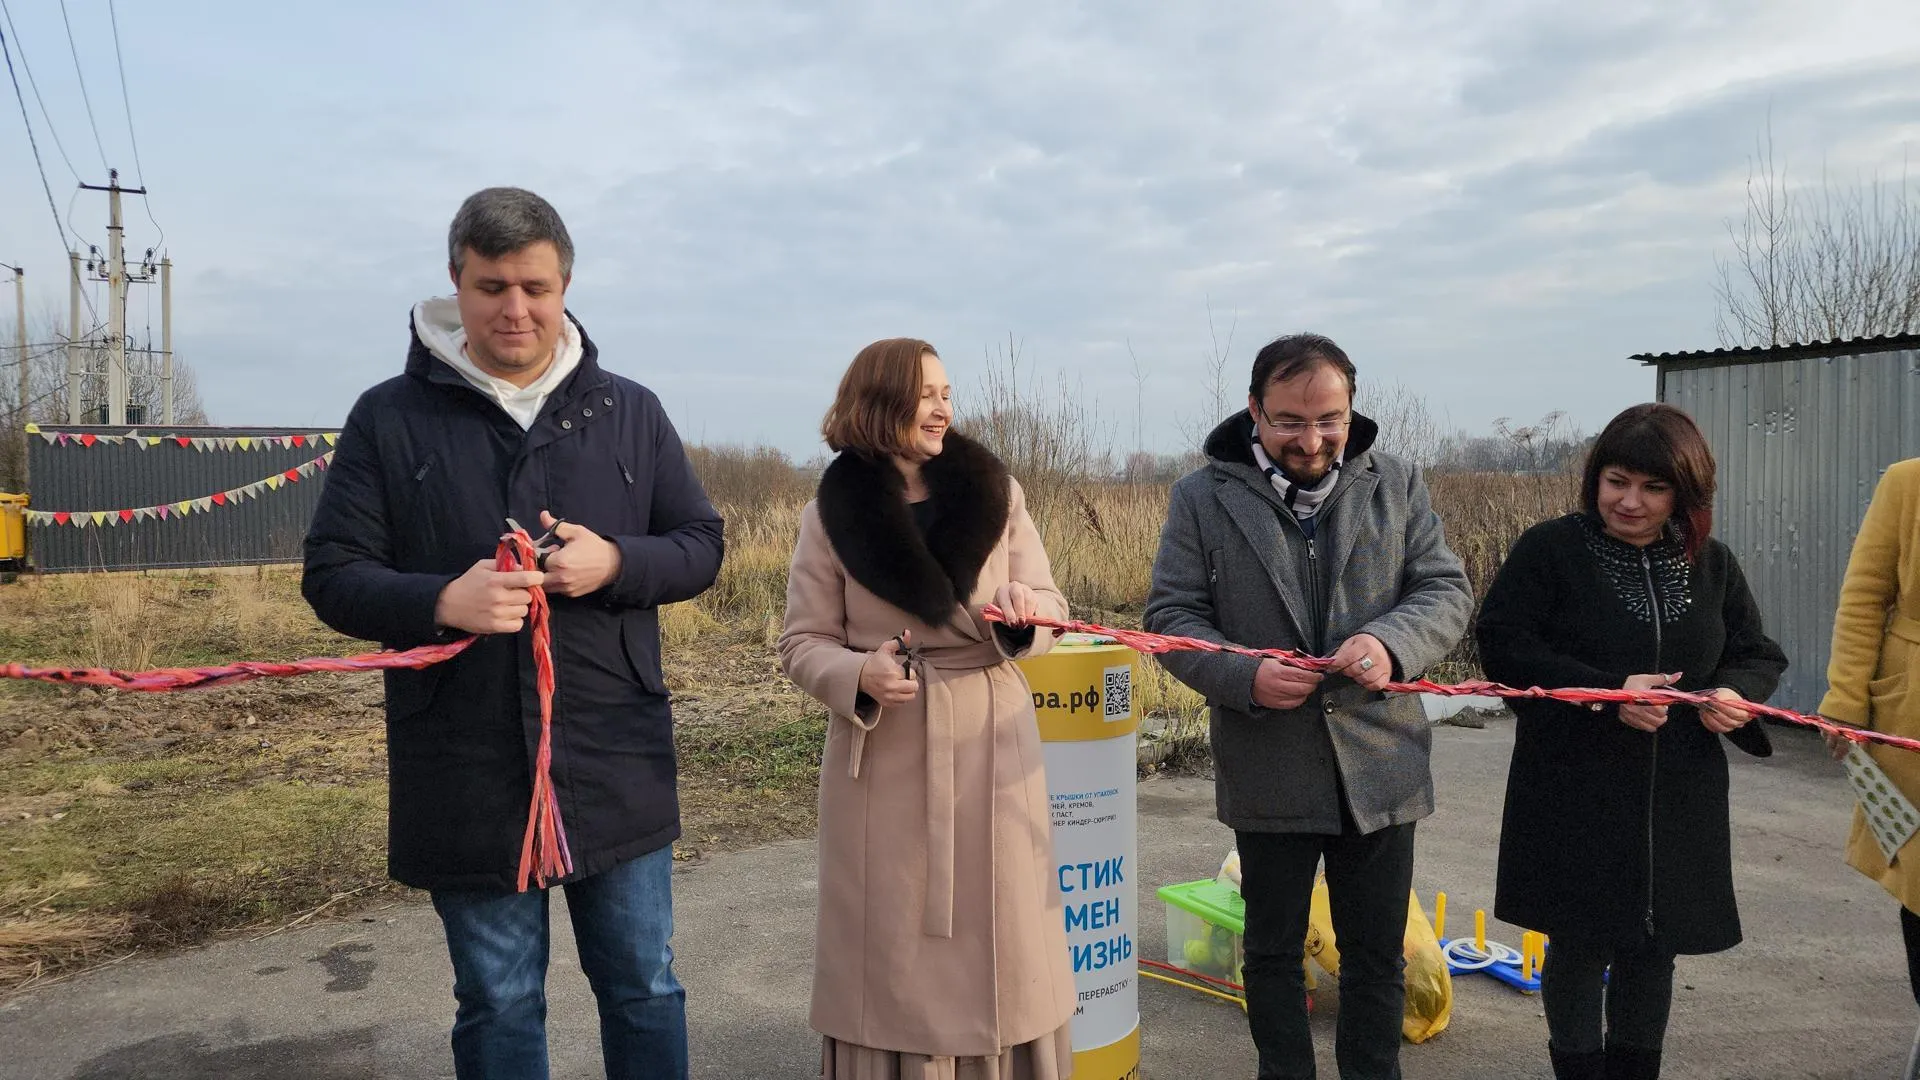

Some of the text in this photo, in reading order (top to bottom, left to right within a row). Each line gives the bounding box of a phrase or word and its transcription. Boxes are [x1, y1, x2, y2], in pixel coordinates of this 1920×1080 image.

[1032, 684, 1099, 714] ра.рф
[1051, 801, 1095, 810] НЕЙ, КРЕМОВ,
[1056, 793, 1084, 801] КРЫШКИ
[1058, 855, 1124, 892] СТИК
[1065, 897, 1119, 933] МЕН
[1068, 933, 1132, 973] ИЗНЬ
[1078, 978, 1129, 1001] ПЕРЕРАБОТКУ
[1073, 1005, 1084, 1016] М
